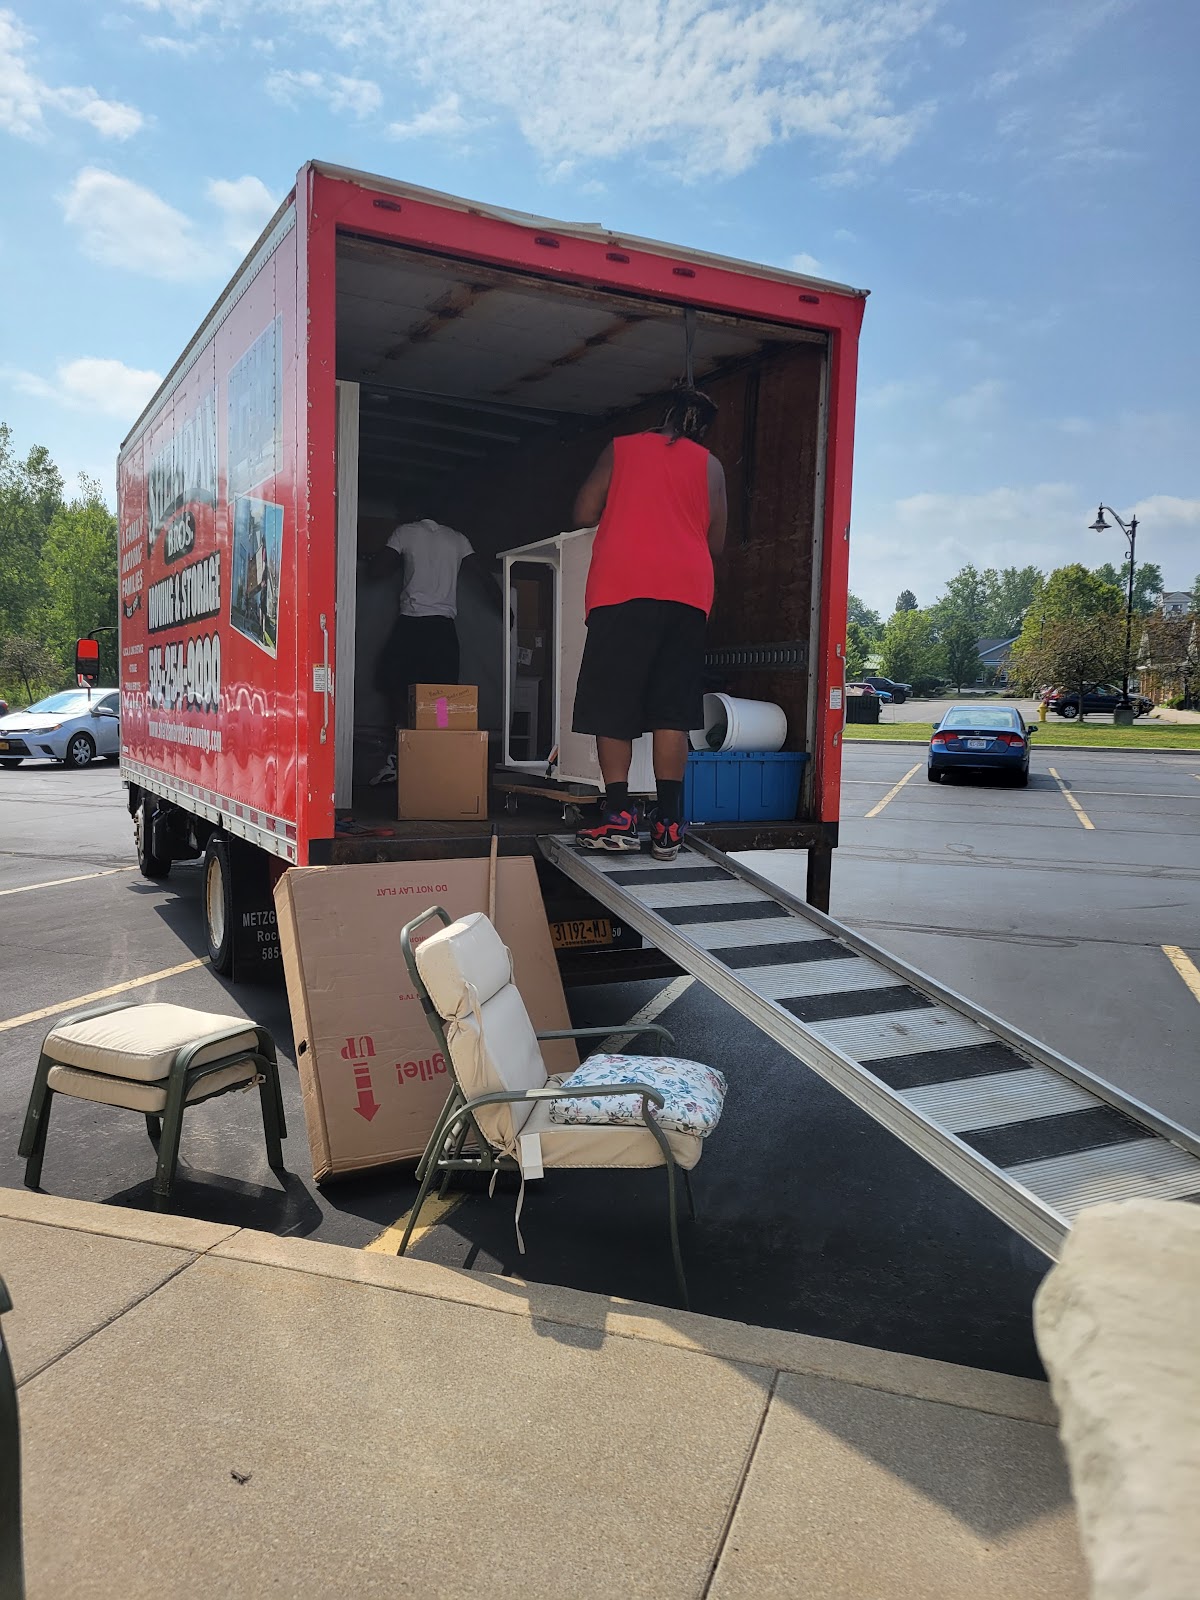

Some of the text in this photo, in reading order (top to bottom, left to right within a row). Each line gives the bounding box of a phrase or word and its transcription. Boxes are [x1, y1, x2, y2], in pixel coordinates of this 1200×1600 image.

[149, 384, 219, 544] SHERIDAN
[167, 516, 194, 557] BROS.
[122, 569, 143, 598] FAMILIES
[149, 577, 174, 630] MOVING
[175, 573, 181, 622] &
[181, 553, 221, 620] STORAGE
[149, 634, 221, 708] 585-254-9000
[376, 884, 448, 897] DO NOT LAY FLAT
[242, 910, 278, 927] METZG
[257, 931, 279, 942] Roc
[341, 1036, 376, 1059] UP
[395, 1053, 448, 1085] gile!
